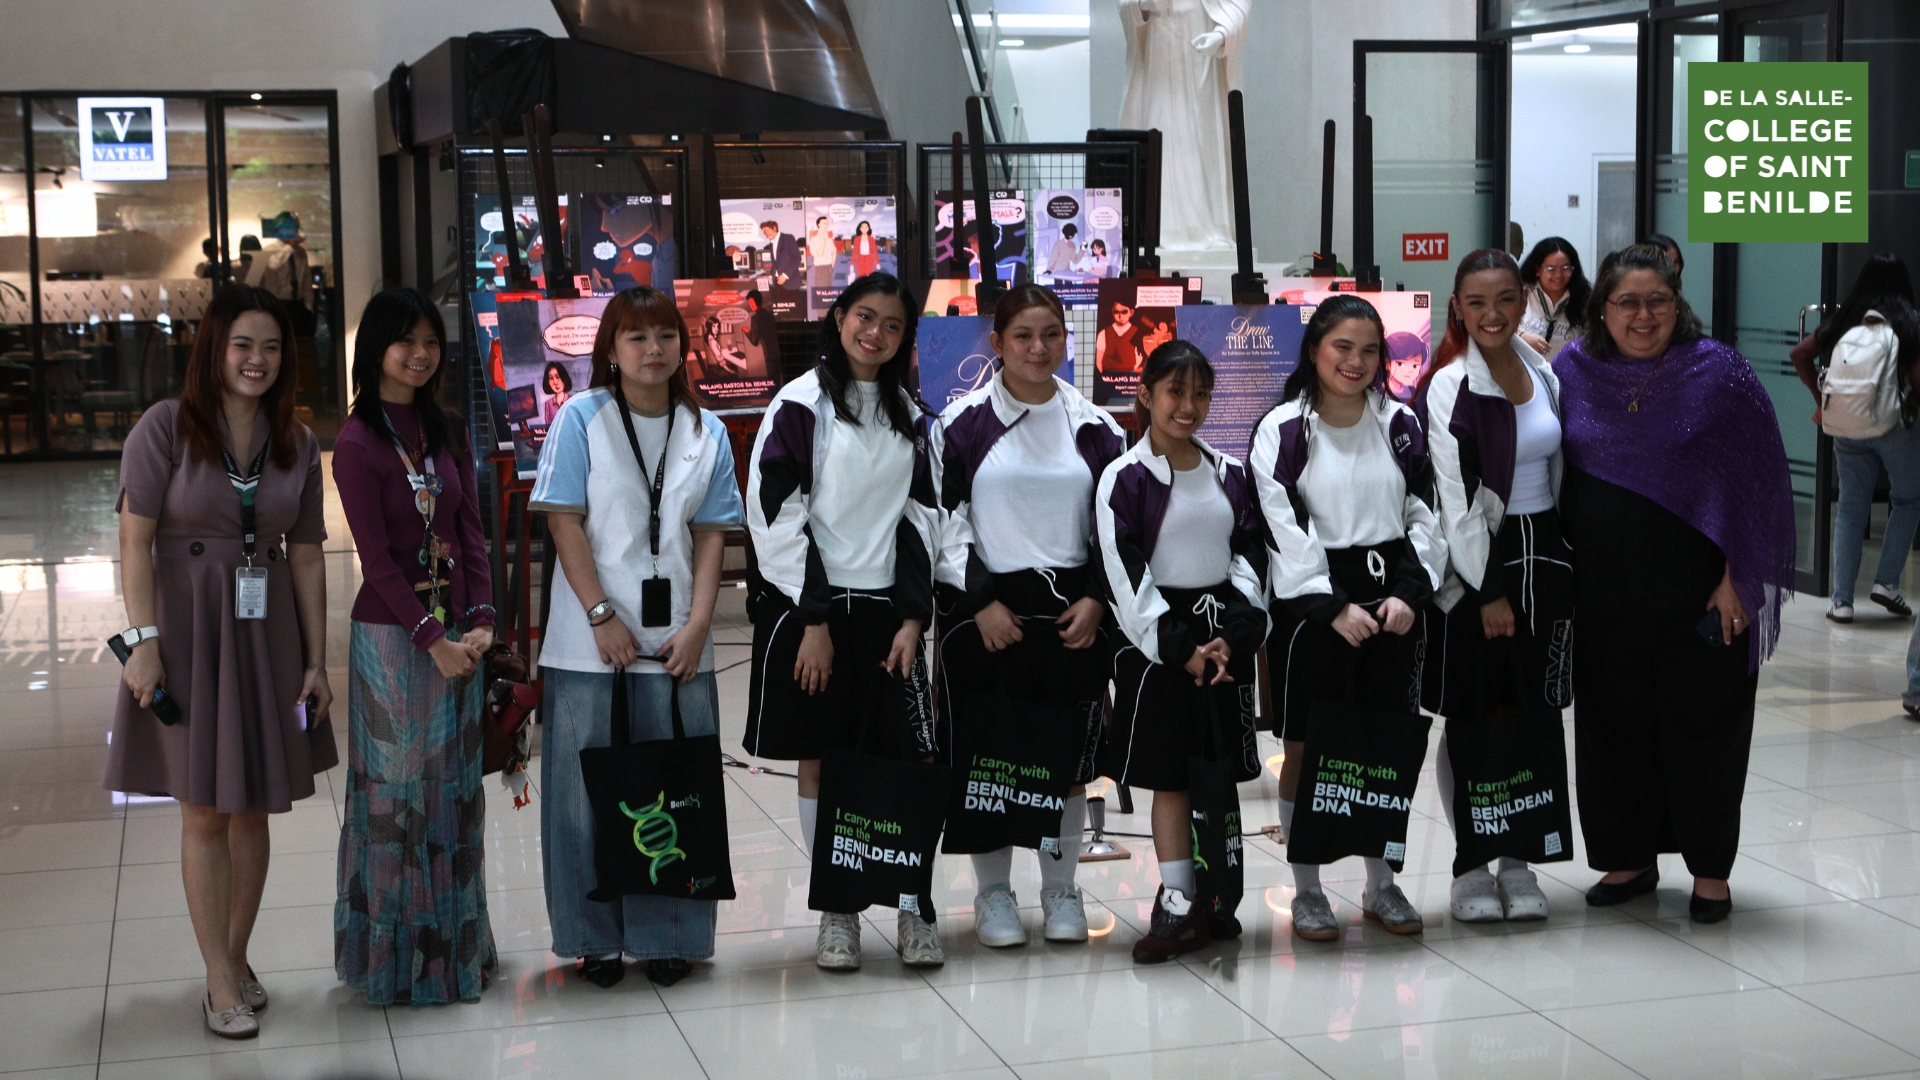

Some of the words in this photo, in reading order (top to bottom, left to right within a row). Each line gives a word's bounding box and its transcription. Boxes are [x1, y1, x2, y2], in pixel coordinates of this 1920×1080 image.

[105, 111, 135, 142] V
[94, 147, 151, 160] VATEL
[1406, 239, 1445, 255] EXIT
[1228, 316, 1270, 337] Draw
[1226, 336, 1248, 349] THE
[1252, 336, 1274, 349] LINE
[916, 692, 925, 720] Dance
[921, 721, 932, 751] Majors
[972, 754, 977, 766] I
[980, 757, 1016, 775] carry
[1020, 765, 1050, 780] with
[1319, 755, 1324, 767] I
[1327, 759, 1365, 776] carry
[1368, 766, 1397, 780] with
[969, 770, 990, 780] me
[995, 771, 1017, 787] the
[1316, 771, 1337, 782] me
[1341, 773, 1365, 788] the
[1468, 780, 1472, 792] I
[1476, 779, 1508, 792] carry
[1510, 769, 1534, 786] with
[964, 795, 1006, 814] DNA
[967, 780, 1066, 811] BENILDEAN
[1314, 782, 1412, 812] BENILDEAN
[1470, 796, 1490, 806] me
[1493, 791, 1510, 804] the
[1471, 789, 1554, 820] BENILDEAN
[1312, 797, 1351, 817] DNA
[836, 807, 840, 820] I
[844, 812, 870, 830] carry
[874, 820, 901, 835] with
[1473, 818, 1510, 835] DNA
[835, 824, 853, 836] me
[856, 827, 870, 842] the
[831, 850, 863, 872] DNA
[833, 835, 922, 867] BENILDEAN
